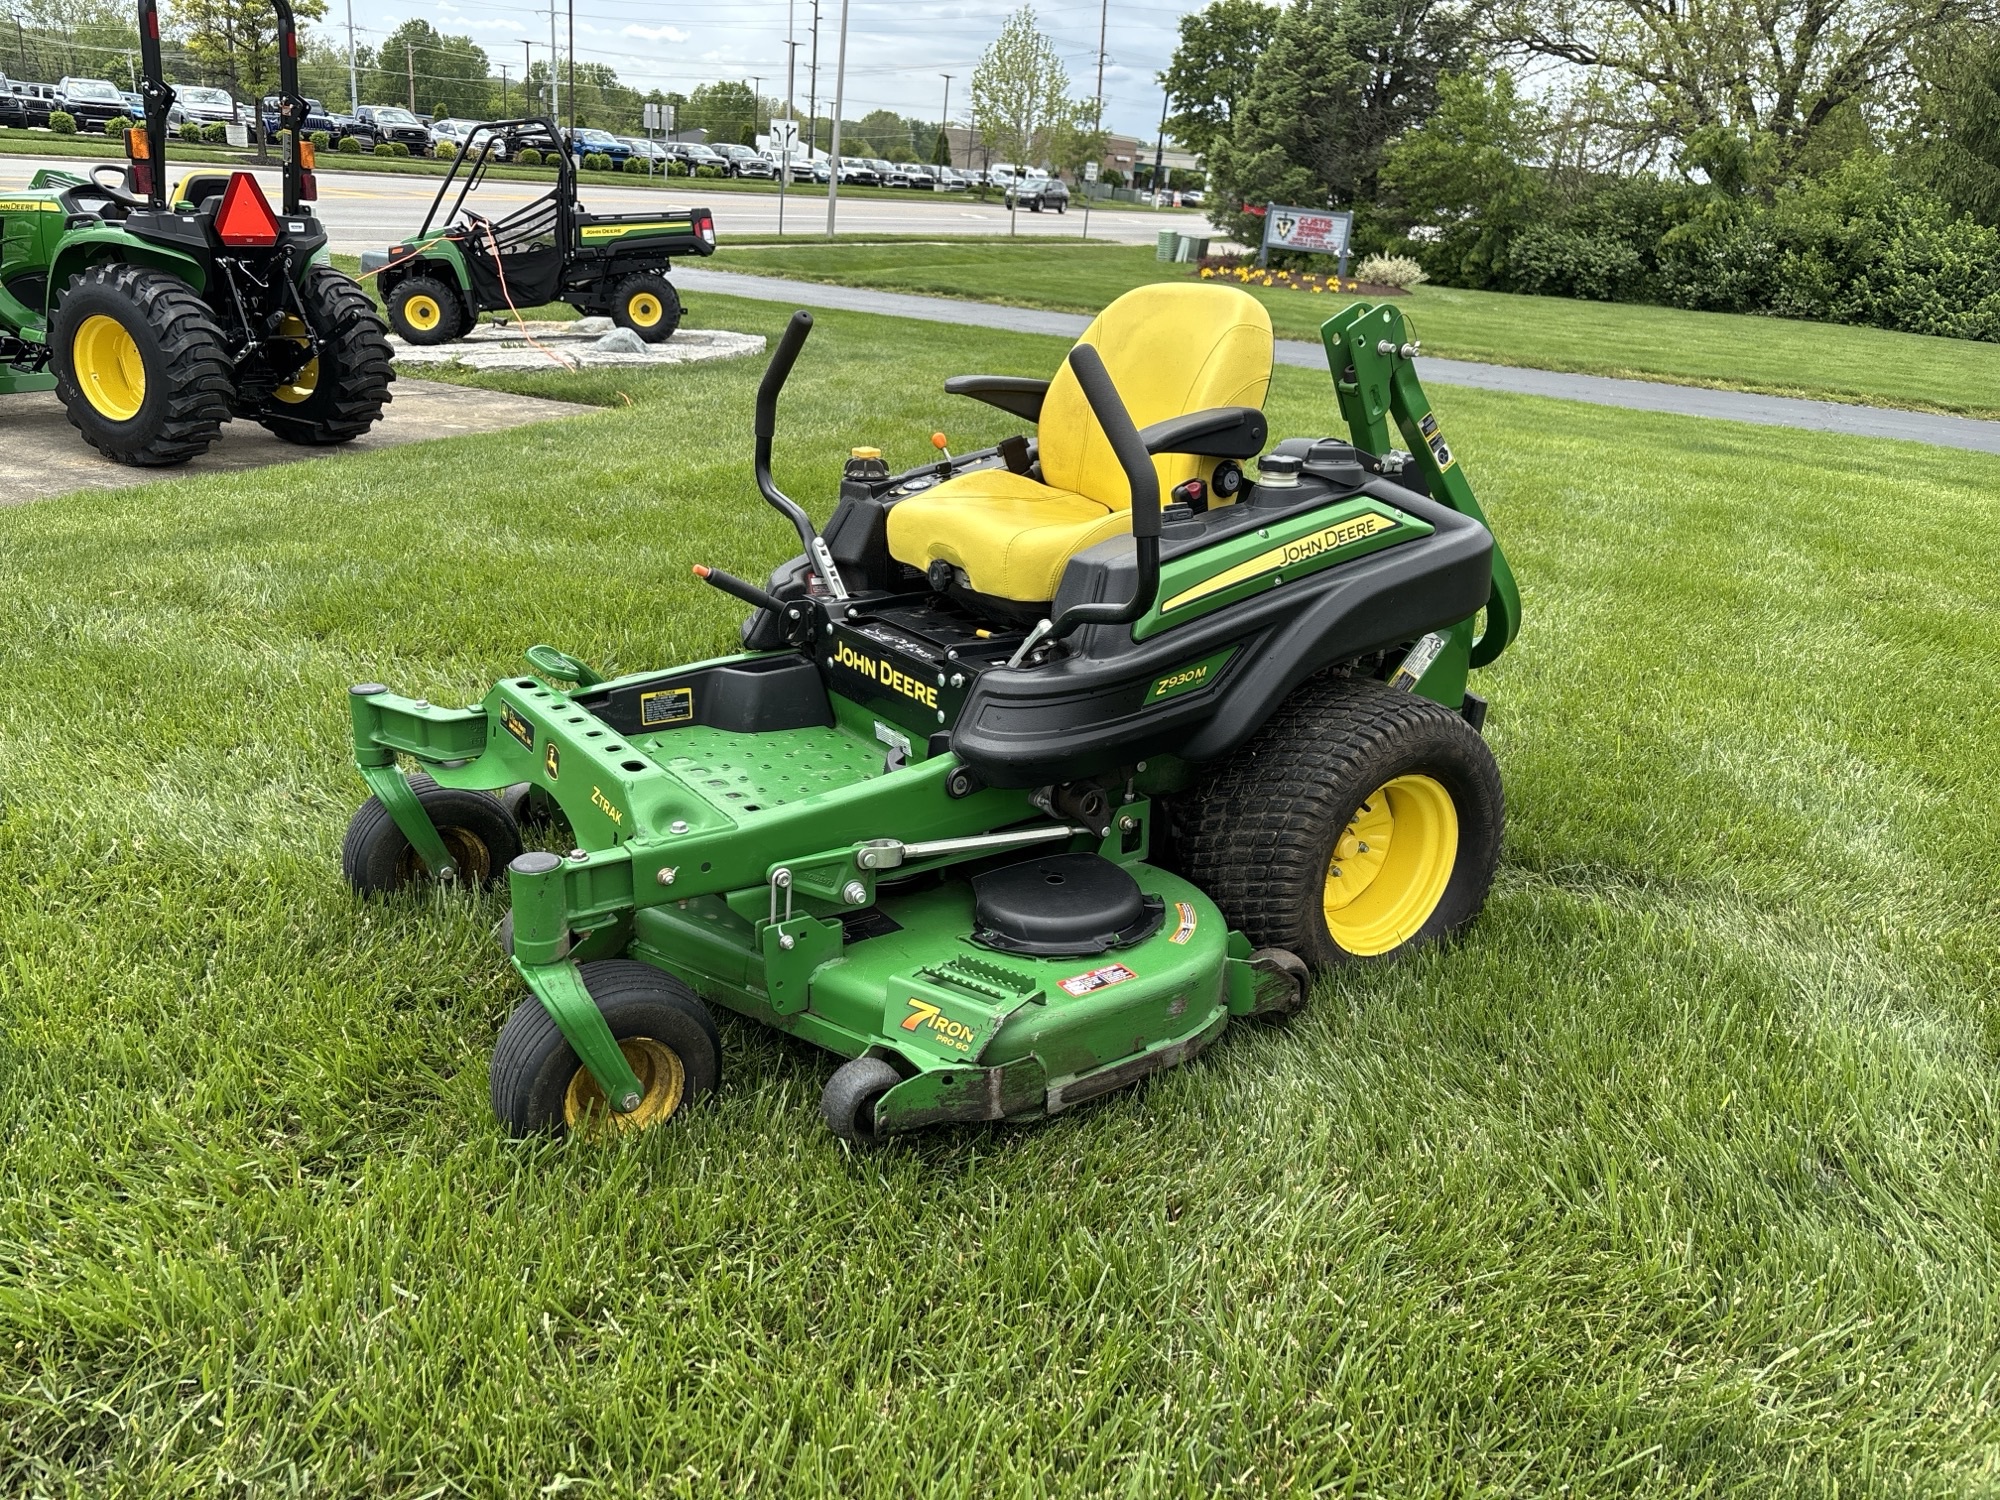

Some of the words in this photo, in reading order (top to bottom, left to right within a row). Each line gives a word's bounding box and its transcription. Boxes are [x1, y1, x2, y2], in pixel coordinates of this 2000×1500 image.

[1299, 217, 1333, 228] CUSTIS
[1280, 538, 1322, 565] JOHN
[1324, 519, 1376, 548] DEERE
[834, 640, 876, 680] JOHN
[880, 660, 938, 709] DEERE
[1156, 665, 1207, 696] Z930M
[591, 785, 622, 826] ZTRAK
[900, 997, 942, 1032] 7
[926, 1013, 975, 1044] IRON
[935, 1034, 955, 1047] PRO
[955, 1042, 970, 1052] 60
